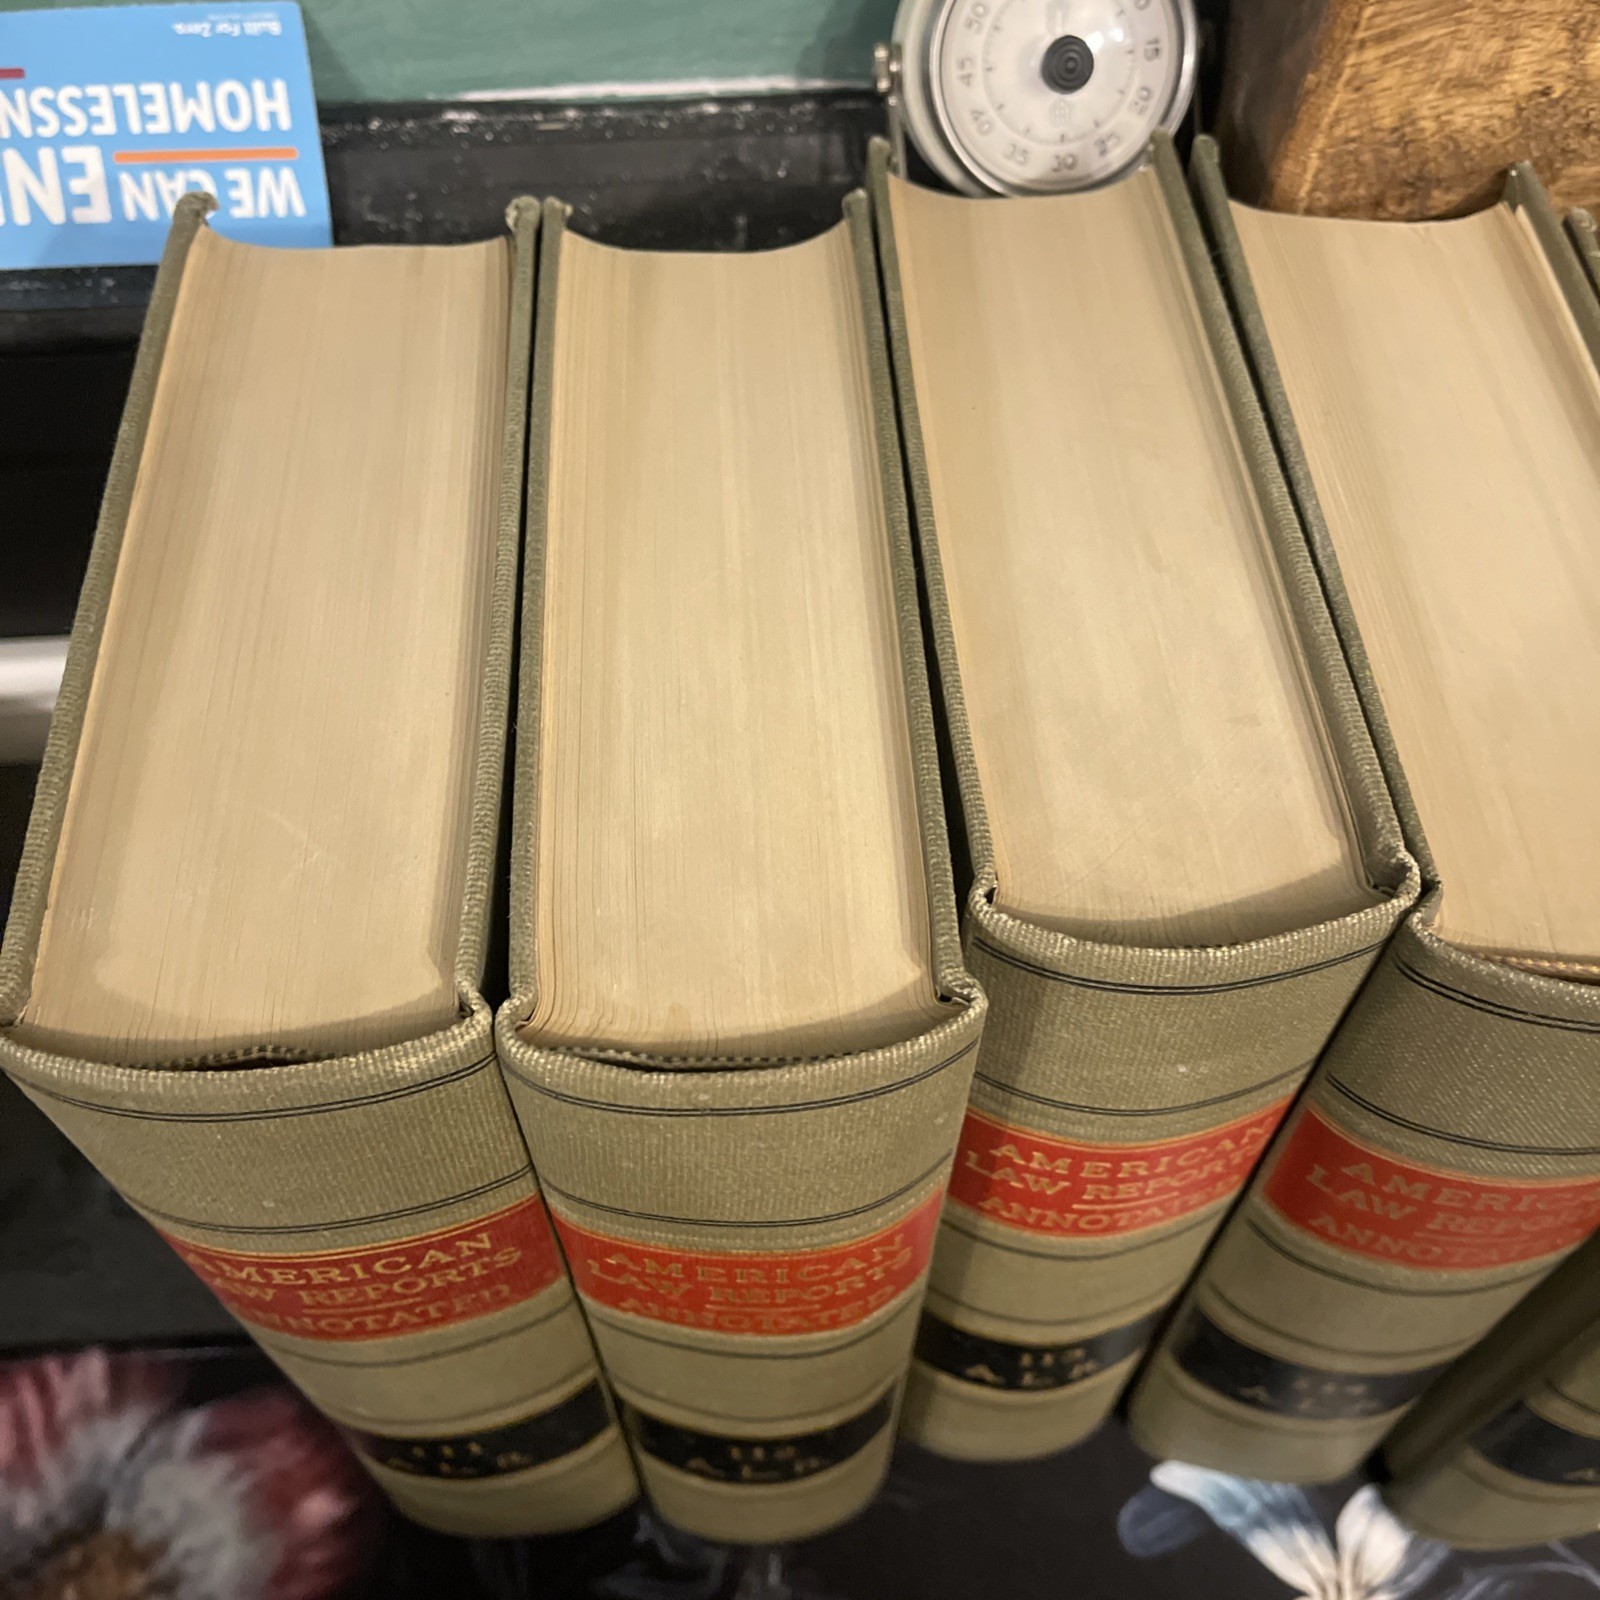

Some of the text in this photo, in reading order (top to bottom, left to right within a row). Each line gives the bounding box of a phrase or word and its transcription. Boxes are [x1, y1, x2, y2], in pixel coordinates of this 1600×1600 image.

[964, 1, 990, 34] 50
[957, 56, 976, 87] 45
[1144, 37, 1162, 62] 15
[970, 108, 993, 136] 40
[1003, 143, 1031, 167] 35
[1051, 152, 1079, 173] 30
[0, 145, 112, 226] EN
[224, 167, 306, 219] WE
[989, 1116, 1274, 1178] AMERICAN
[965, 1150, 1072, 1197] LAW
[1305, 1163, 1418, 1221] LAW
[185, 1232, 491, 1286] AMERICAN
[213, 1247, 522, 1307] AW REPORTS
[587, 1246, 913, 1305] LAW REPORTS
[603, 1233, 906, 1282] AMERICAN
[245, 1283, 510, 1334] NNOTATED
[618, 1285, 896, 1329] ANNOTATED
